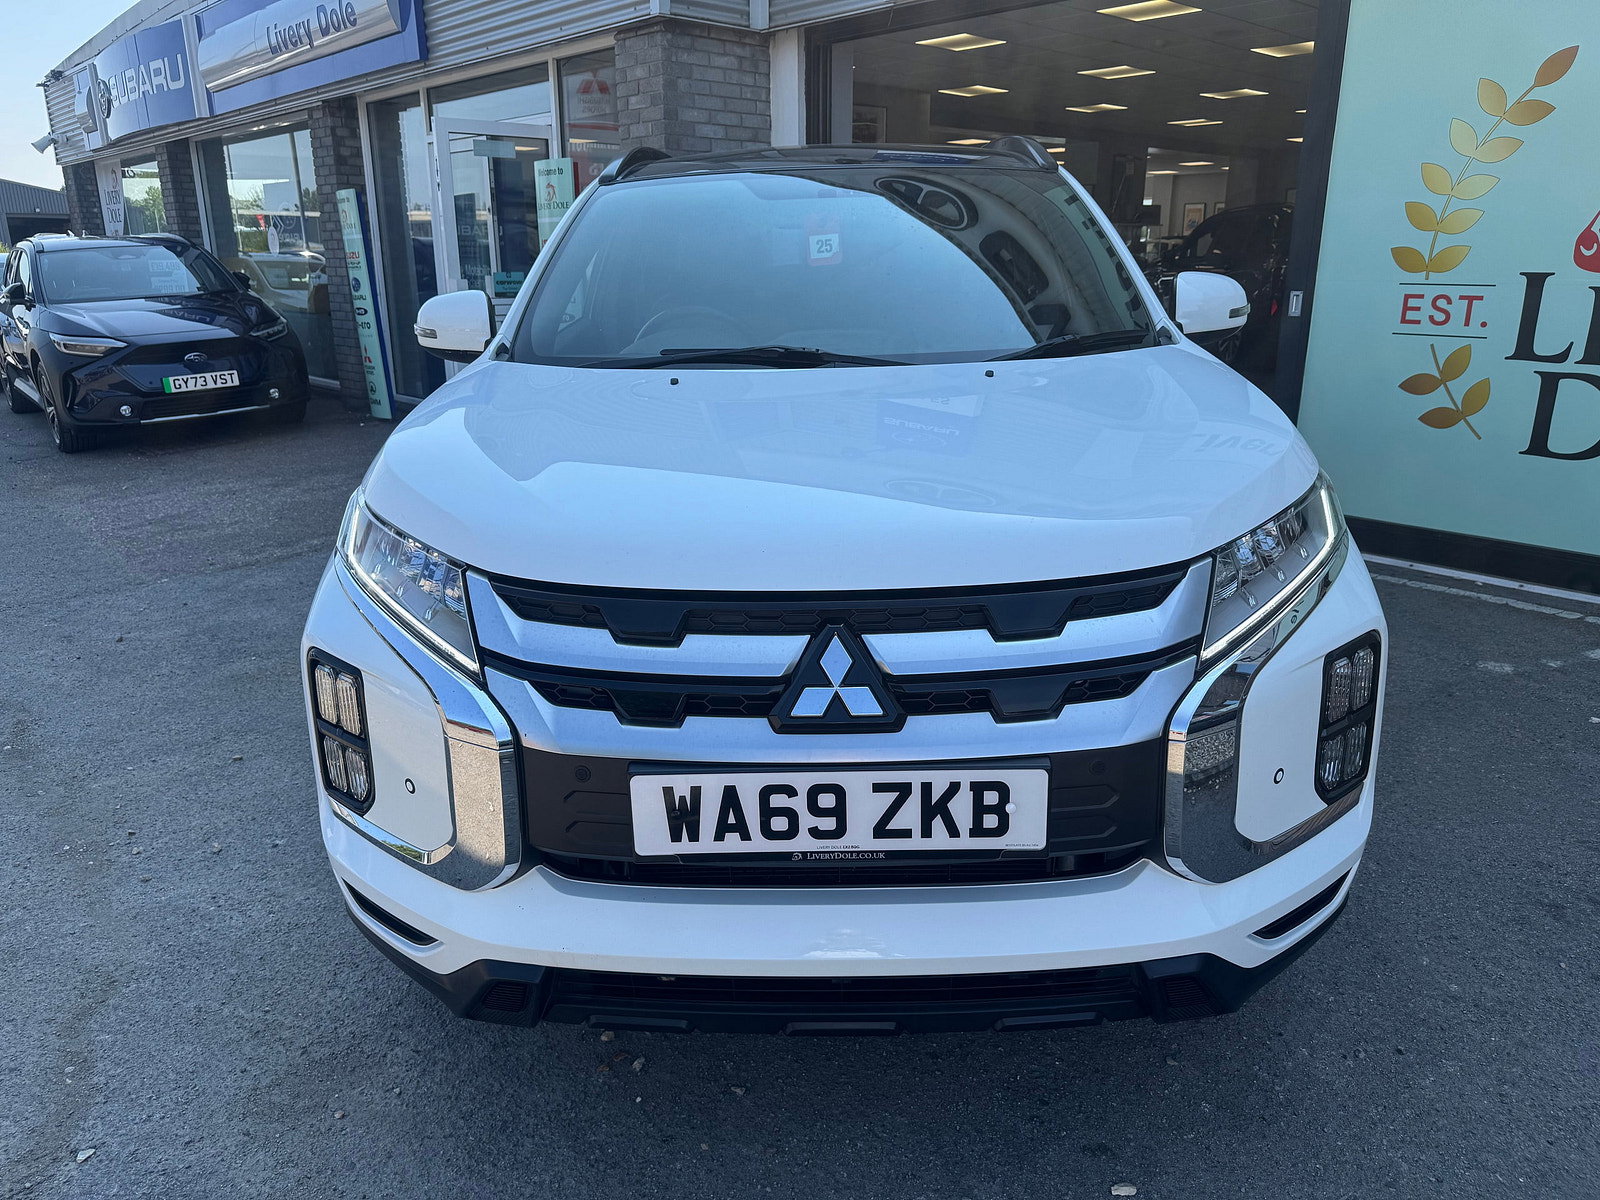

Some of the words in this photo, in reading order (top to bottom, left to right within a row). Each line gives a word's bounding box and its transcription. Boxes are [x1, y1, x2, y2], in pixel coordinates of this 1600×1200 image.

[266, 18, 315, 55] Livery
[317, 0, 358, 37] Dole
[108, 53, 185, 109] SUBARU
[816, 238, 833, 254] 25
[1399, 293, 1488, 328] EST.
[172, 375, 208, 390] GY73
[210, 372, 235, 386] VST
[661, 783, 848, 843] WA69
[871, 780, 1012, 840] ZKB
